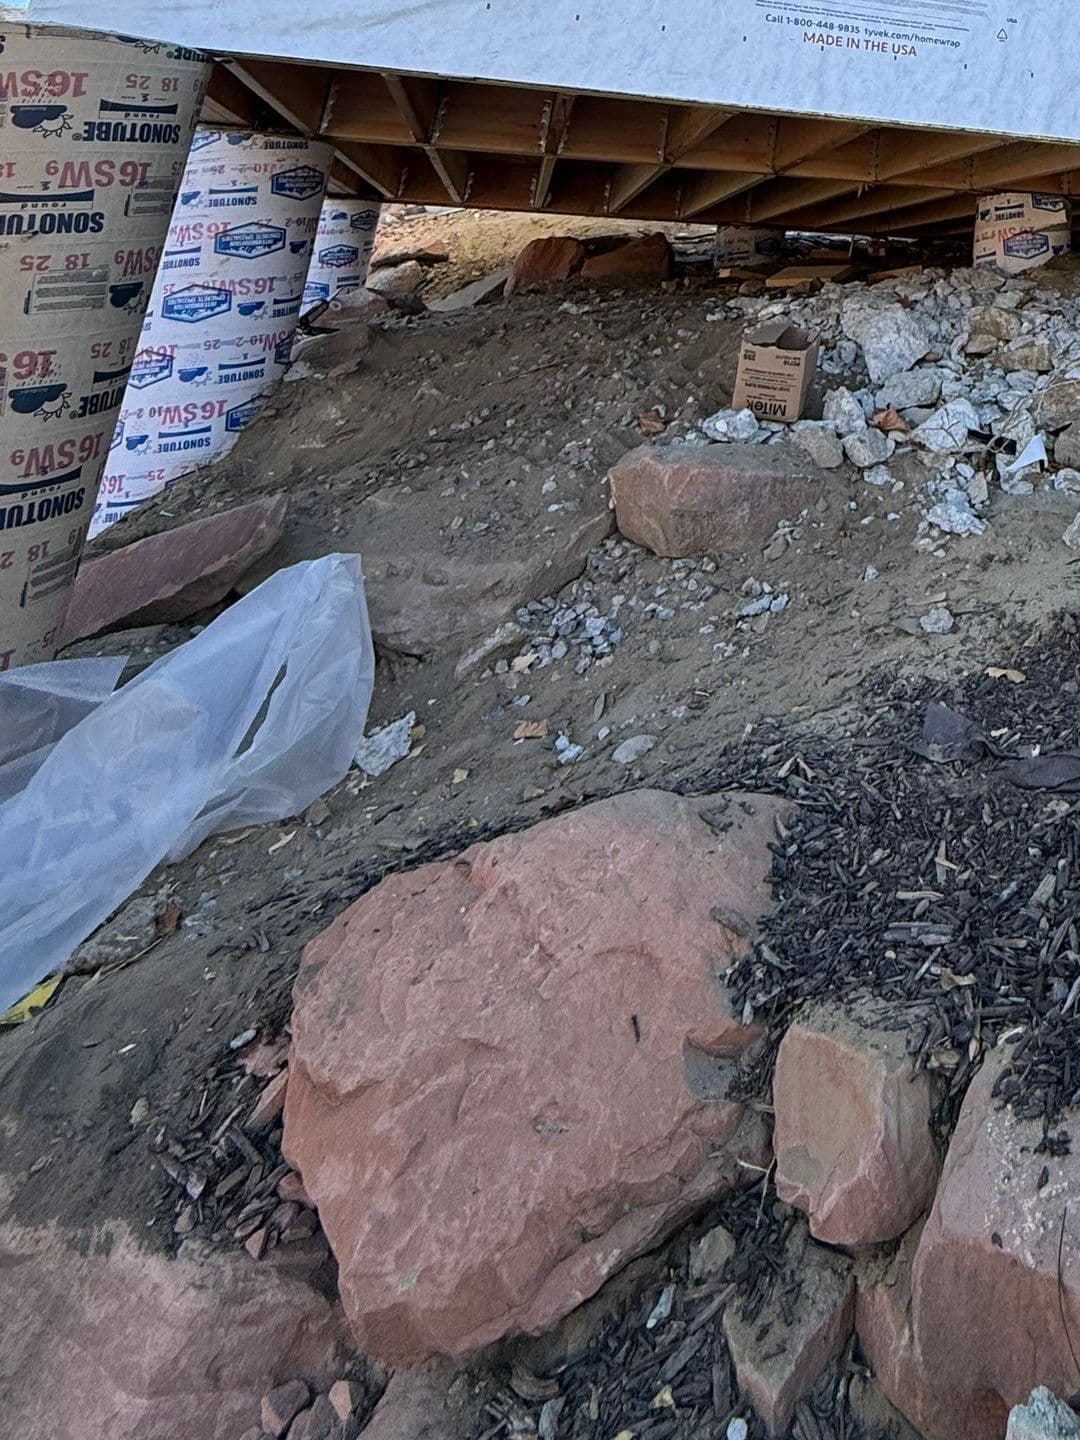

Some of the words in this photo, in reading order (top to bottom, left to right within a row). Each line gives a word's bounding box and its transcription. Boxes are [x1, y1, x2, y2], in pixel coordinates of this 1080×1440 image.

[765, 13, 784, 25] Call
[786, 17, 860, 34] 1-800-448-9835
[864, 28, 961, 48] tyvek.com/homewrap
[803, 32, 843, 48] MADE
[846, 37, 860, 49] IN
[864, 40, 889, 53] THE
[892, 44, 918, 57] USA
[126, 74, 151, 91] 25
[161, 77, 179, 92] 18
[20, 255, 51, 271] 25
[66, 254, 90, 271] 18
[91, 341, 112, 359] 25
